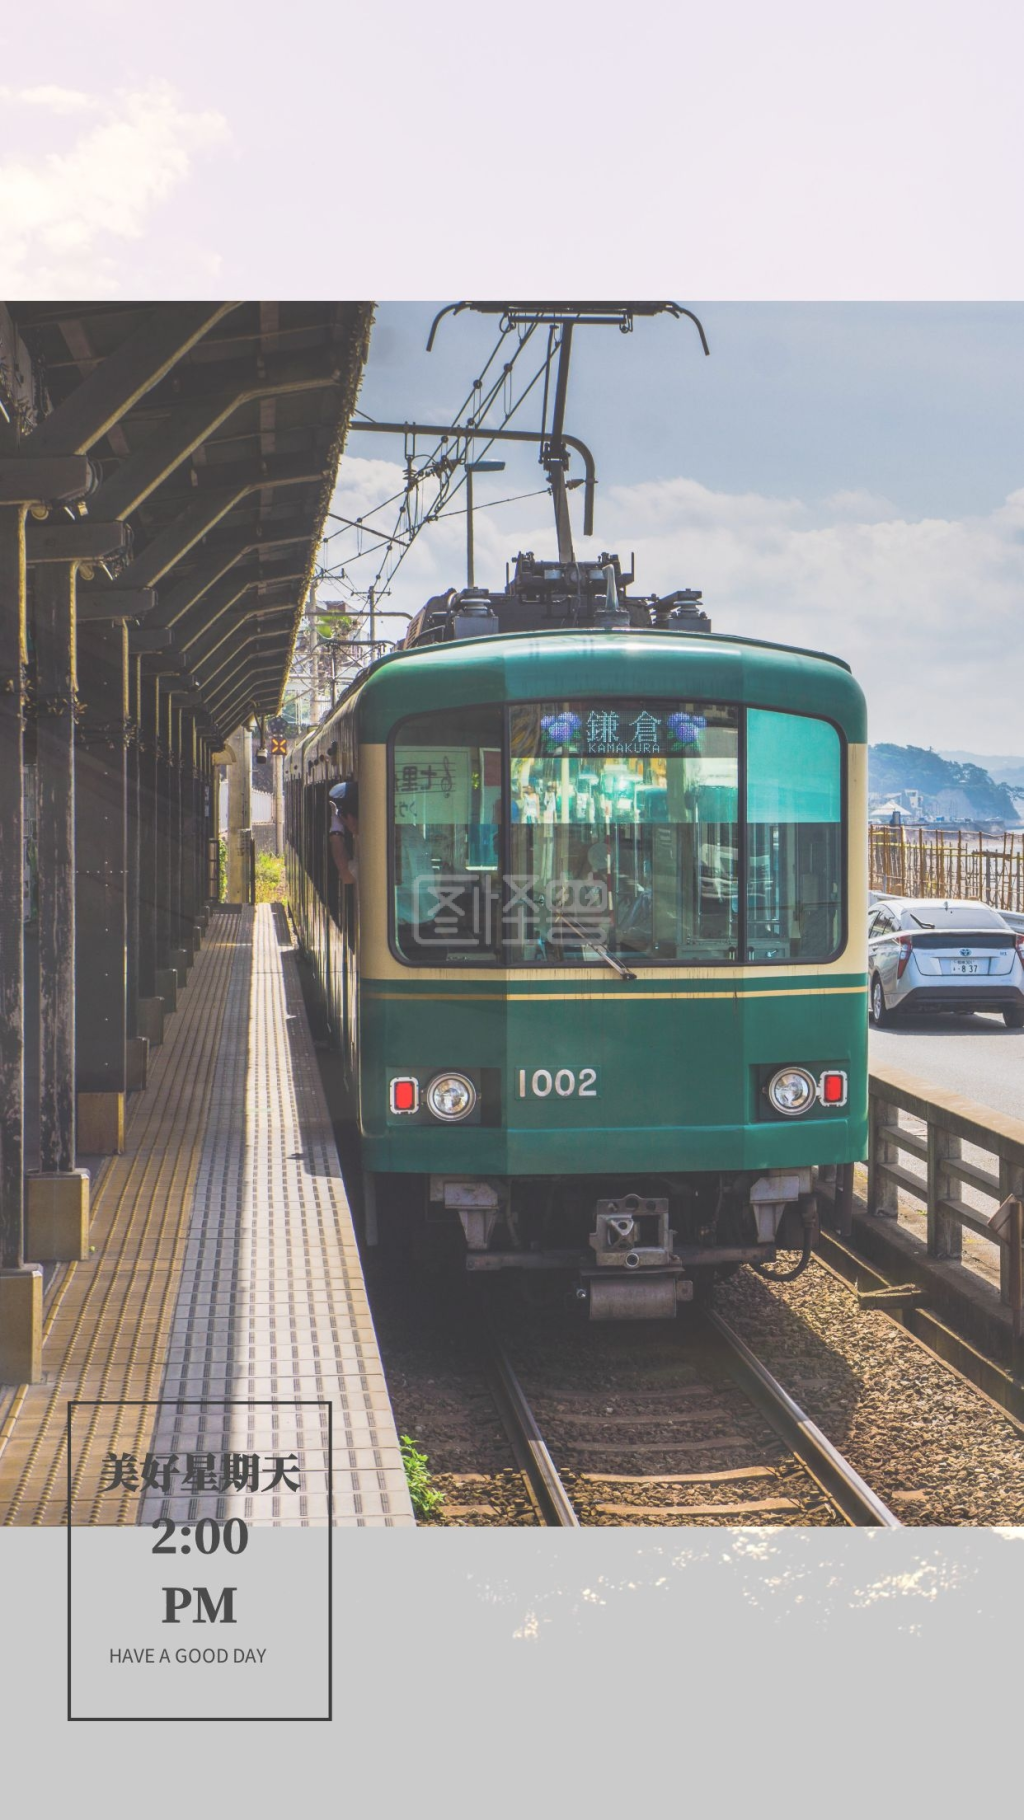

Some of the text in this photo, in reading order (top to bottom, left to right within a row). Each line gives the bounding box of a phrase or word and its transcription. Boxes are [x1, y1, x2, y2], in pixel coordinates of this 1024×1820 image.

[586, 710, 661, 743] 鎌倉
[588, 742, 660, 754] KAMAKURA
[519, 1068, 597, 1098] 1002
